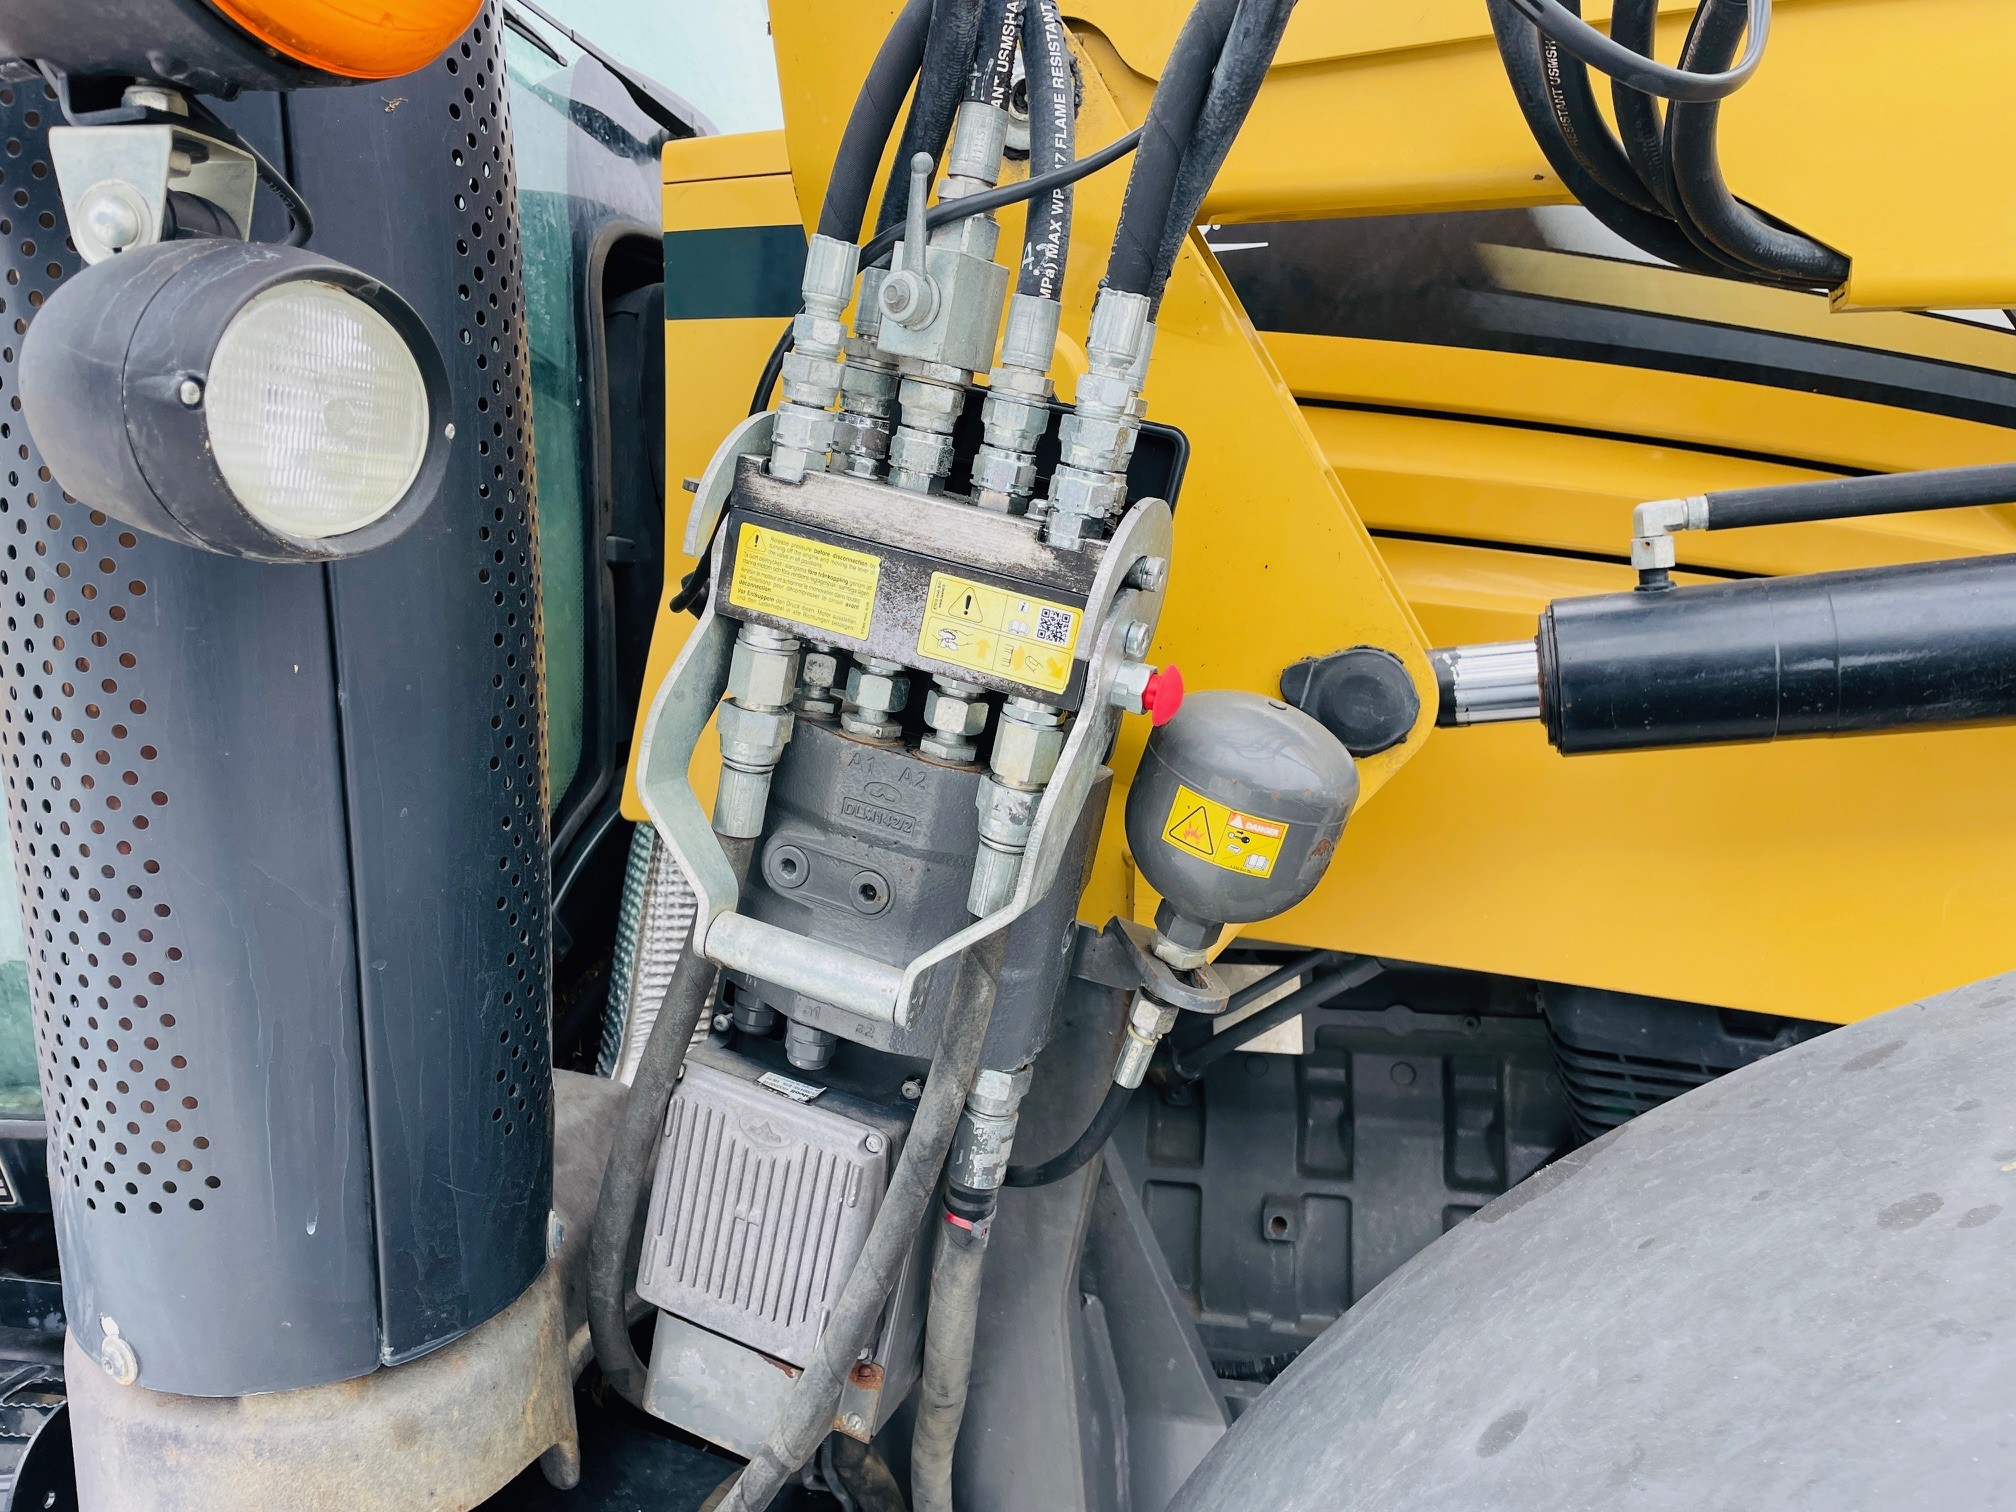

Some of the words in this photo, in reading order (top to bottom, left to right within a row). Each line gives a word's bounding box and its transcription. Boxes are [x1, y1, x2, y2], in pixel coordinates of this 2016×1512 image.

[1040, 2, 1066, 89] RESISTANT
[1054, 93, 1067, 149] FLAME
[1051, 188, 1064, 214] WP
[1045, 219, 1062, 258] MAX
[770, 536, 789, 546] Release
[790, 543, 811, 552] pressure
[813, 548, 830, 557] before
[832, 552, 867, 566] disconnection
[802, 552, 818, 561] engine
[829, 559, 847, 569] moving
[845, 602, 859, 610] avant
[848, 752, 876, 776] A1
[898, 766, 927, 790] A2
[1245, 823, 1280, 837] DANGER
